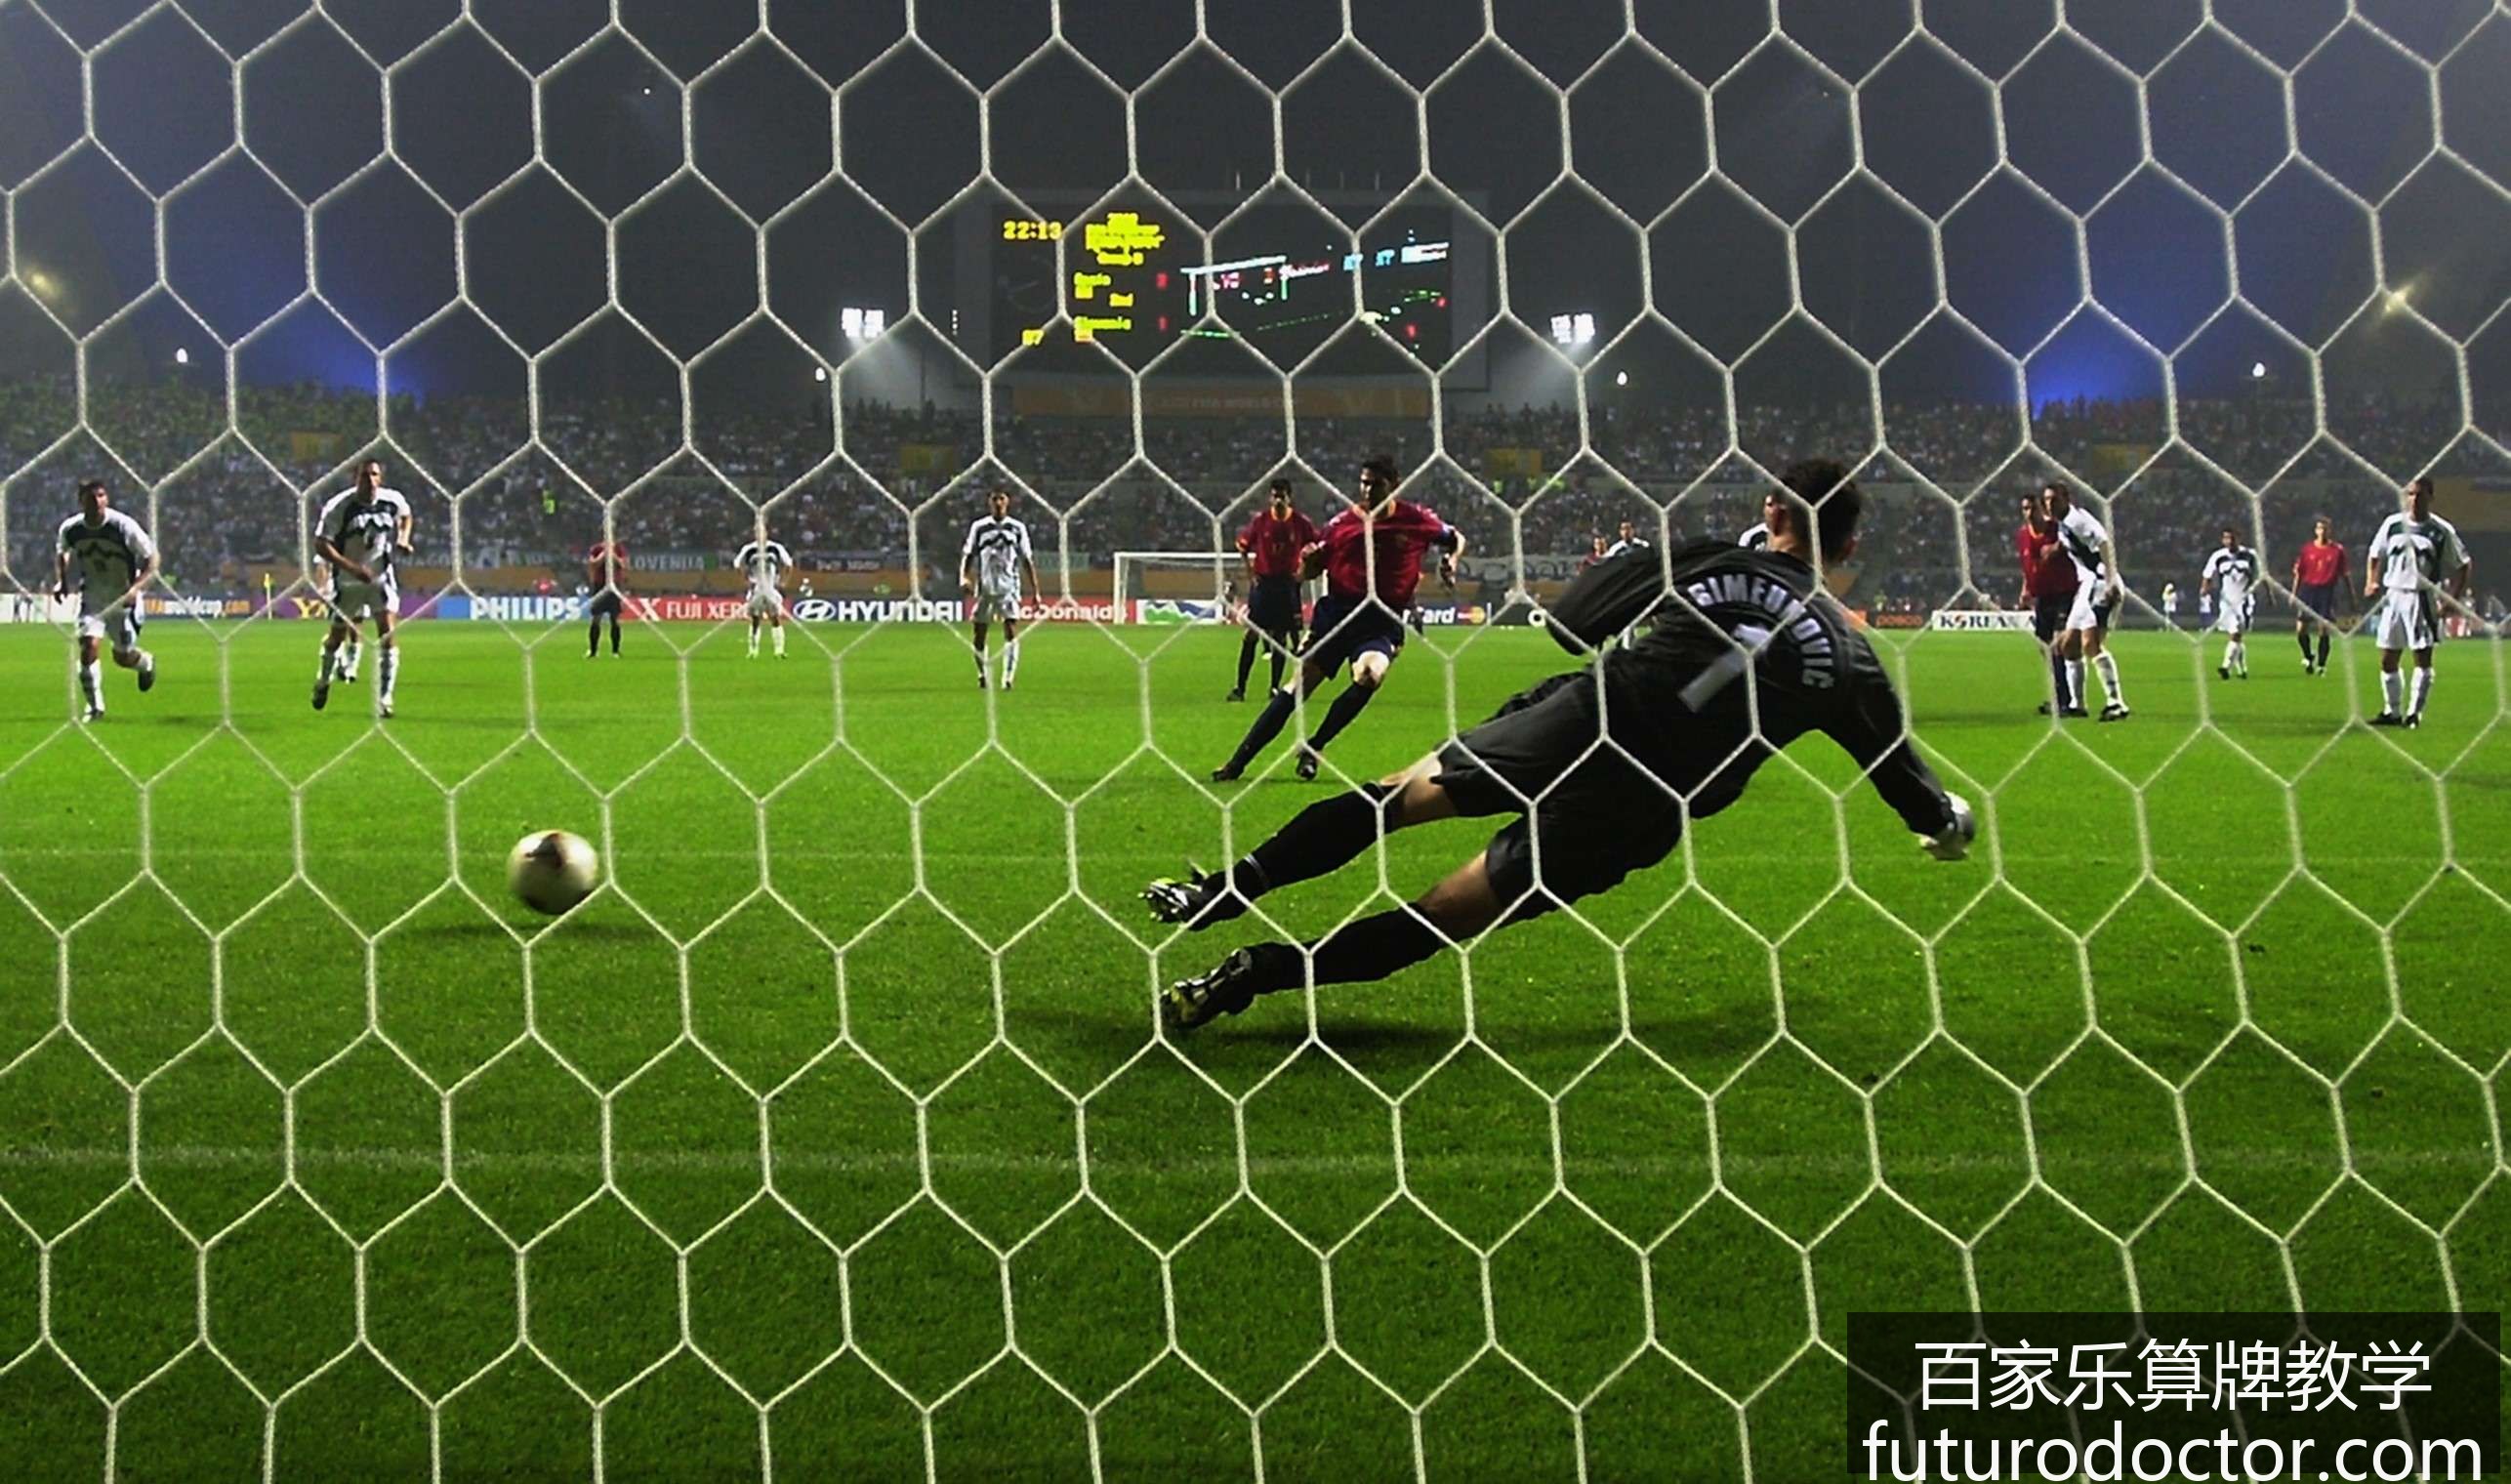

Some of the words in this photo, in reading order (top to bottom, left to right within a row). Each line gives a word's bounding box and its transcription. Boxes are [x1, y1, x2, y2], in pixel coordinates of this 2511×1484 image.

[470, 597, 581, 621] PHILIPS
[666, 600, 702, 619] FUJI
[838, 599, 963, 622] HYUNDAI
